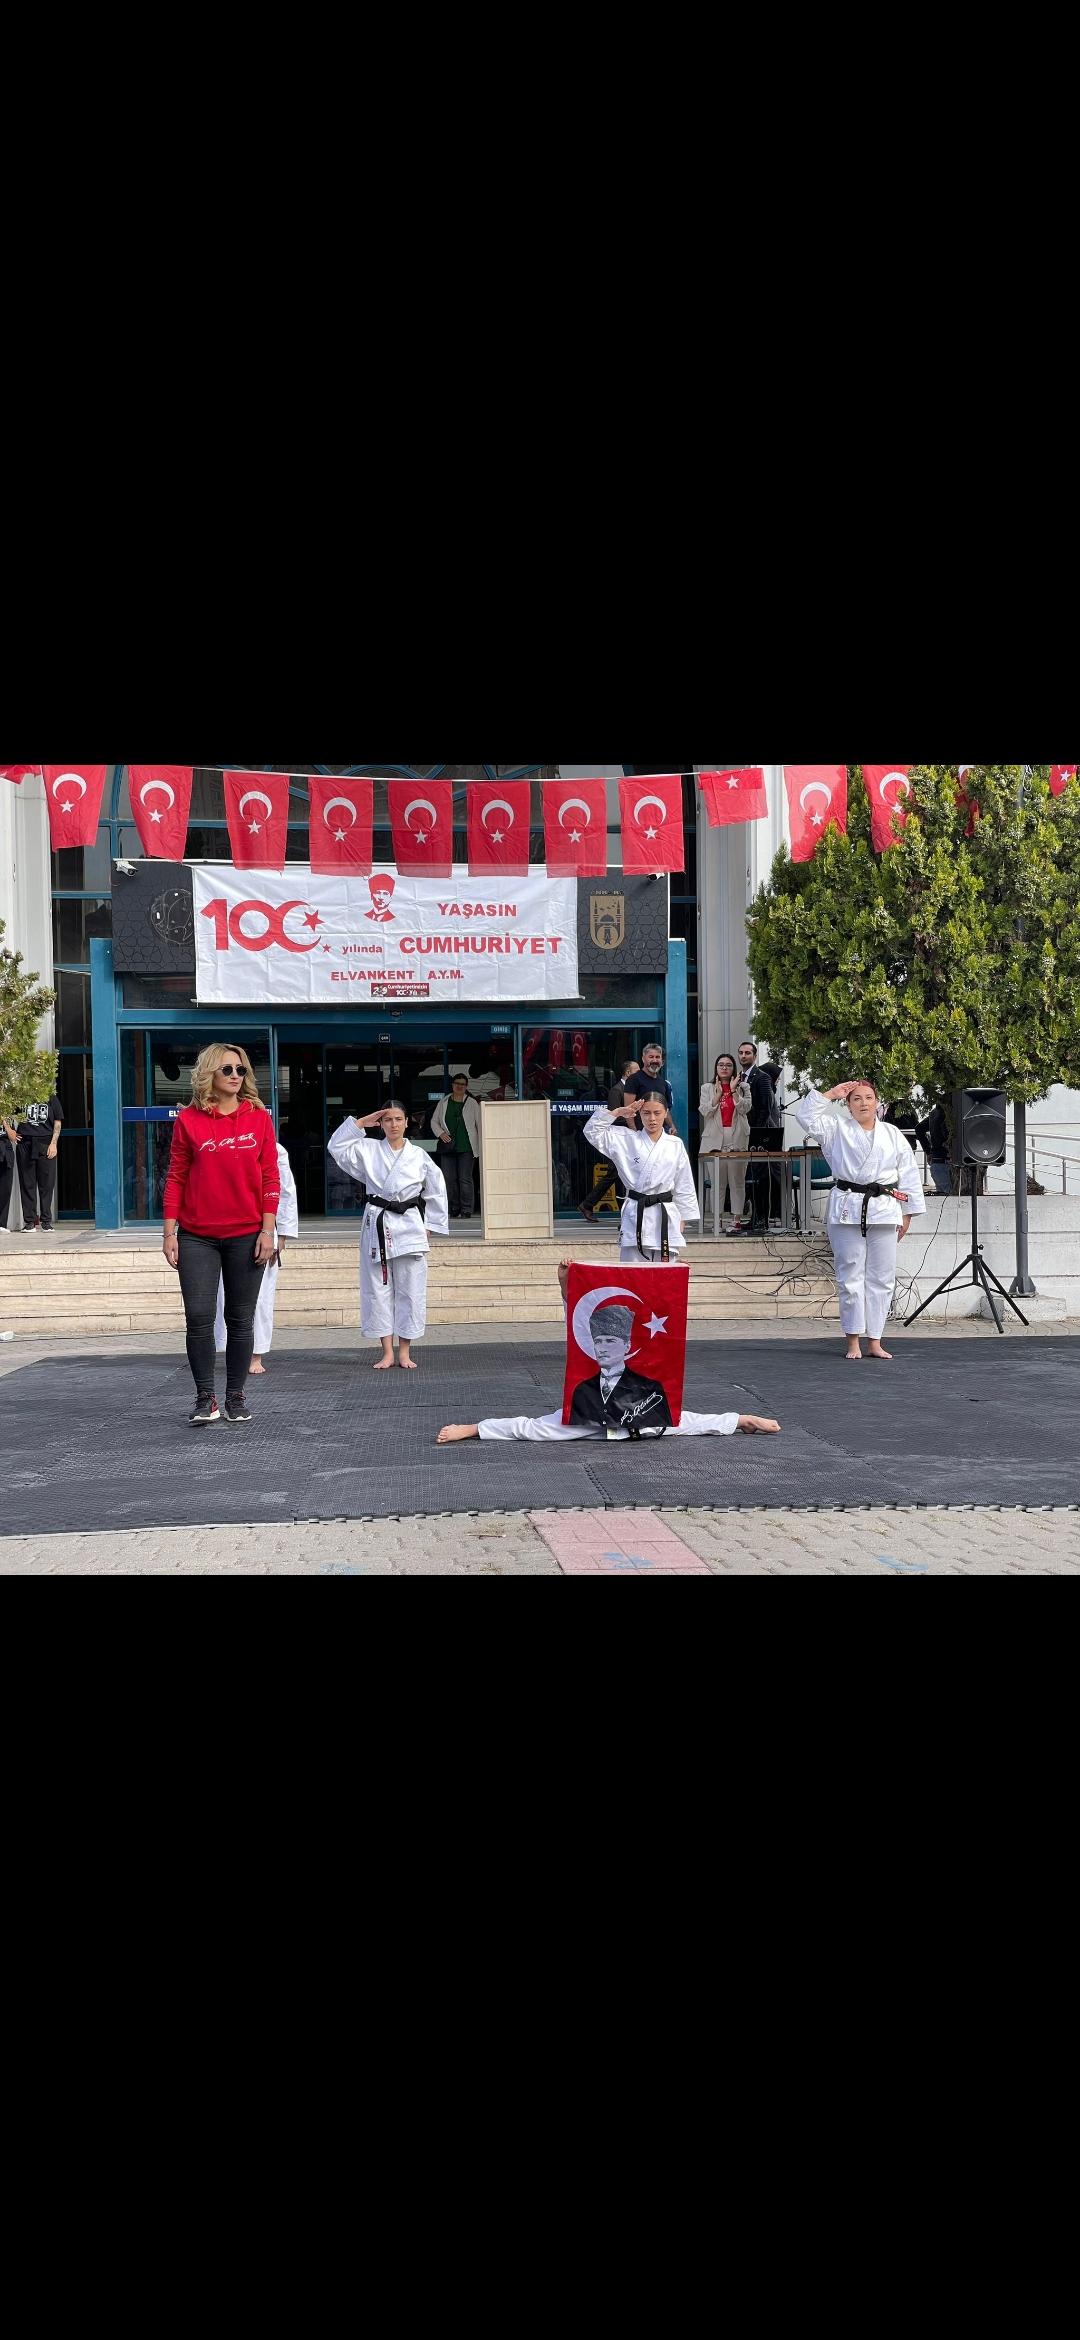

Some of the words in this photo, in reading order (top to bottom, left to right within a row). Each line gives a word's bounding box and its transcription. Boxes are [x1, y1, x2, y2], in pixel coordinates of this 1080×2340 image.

[437, 903, 517, 919] YAŞASIN
[342, 944, 383, 955] yılında
[399, 932, 562, 954] CUMHURİYET
[330, 970, 414, 981] ELVANKENT
[427, 969, 464, 980] A.Y.M.
[558, 1104, 583, 1113] YAŞAM
